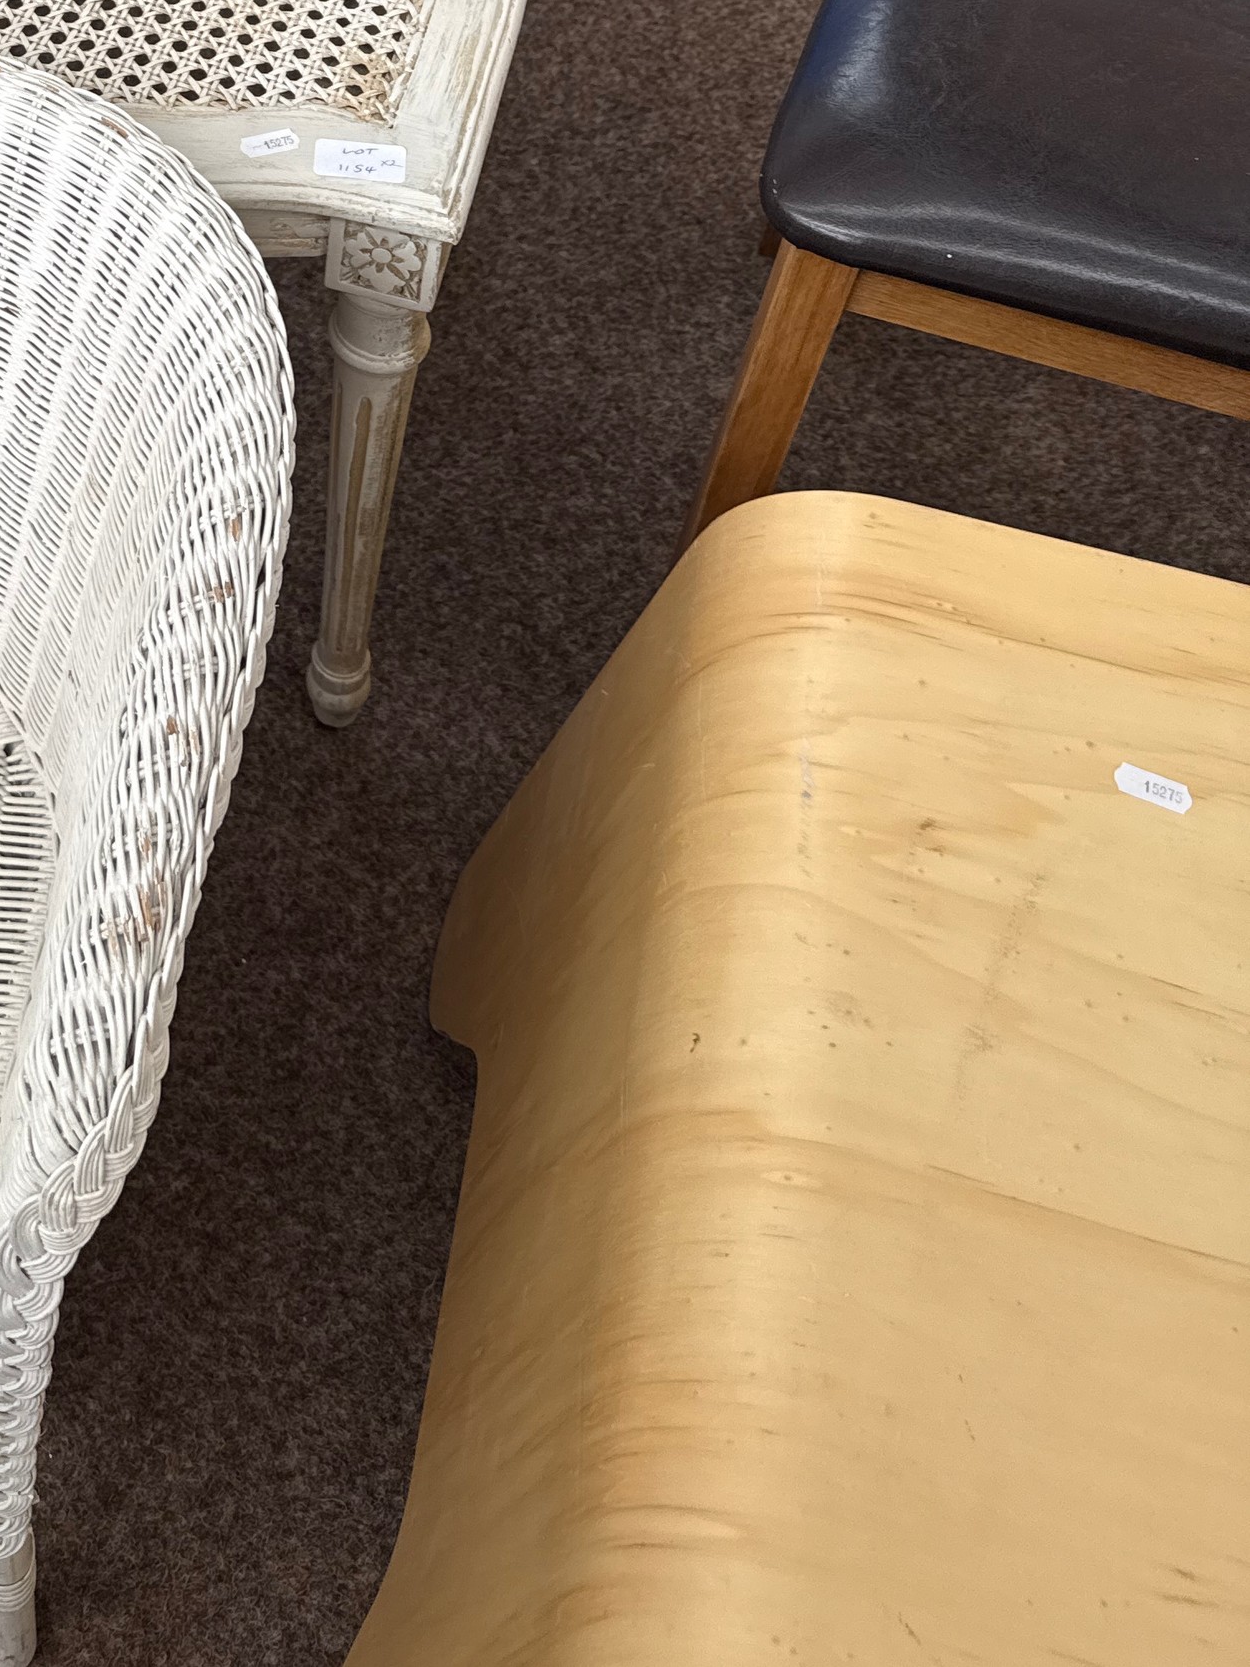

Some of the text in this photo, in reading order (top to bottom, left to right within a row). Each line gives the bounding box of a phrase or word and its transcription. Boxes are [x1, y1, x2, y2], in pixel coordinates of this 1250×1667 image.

[263, 135, 295, 150] 15275
[342, 147, 379, 155] LOT
[338, 163, 377, 174] 1154
[1144, 780, 1183, 804] 15275
